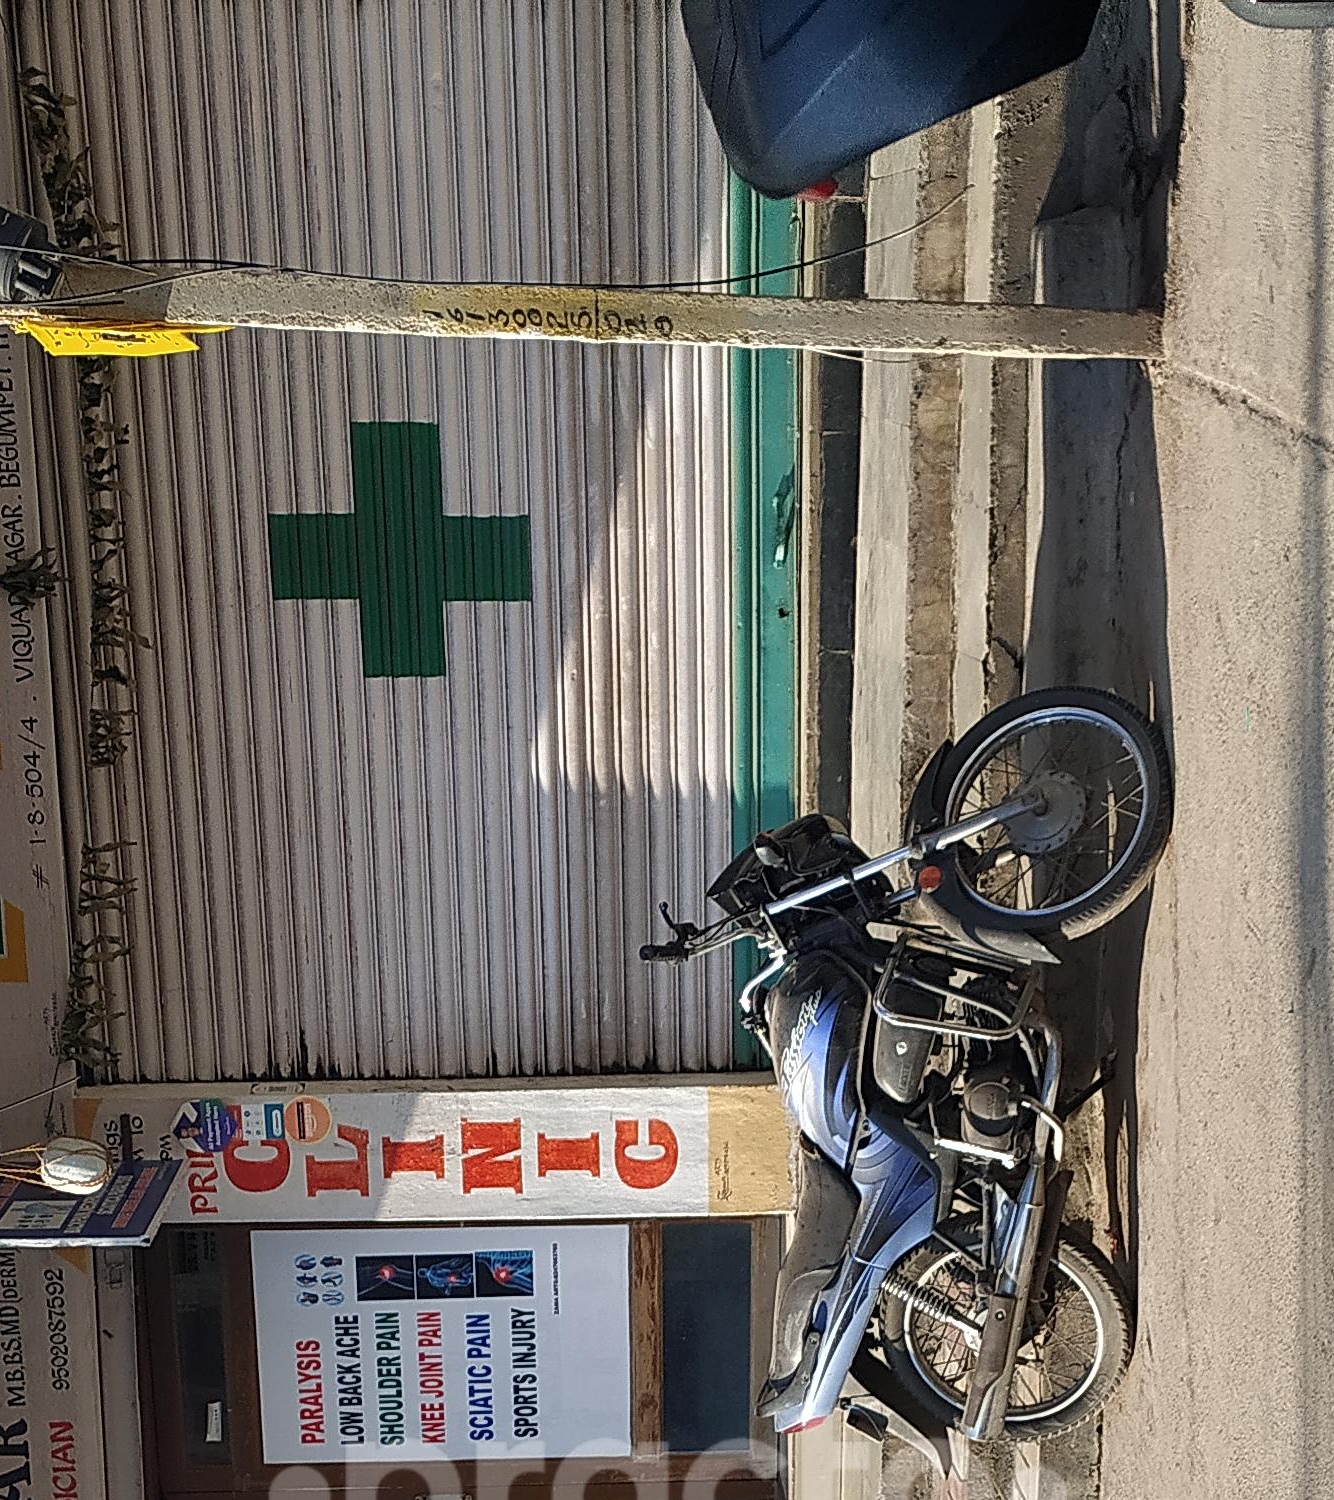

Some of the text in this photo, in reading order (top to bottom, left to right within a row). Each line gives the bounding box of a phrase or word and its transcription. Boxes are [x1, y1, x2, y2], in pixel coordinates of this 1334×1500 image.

[43, 1267, 70, 1391] 9502087592
[294, 1339, 326, 1445] PARALYSIS
[334, 1314, 365, 1445] LOW BACK ACHE
[374, 1312, 405, 1446] SHOULDER PAIN
[416, 1311, 446, 1444] KNEE JOINT PAIN
[465, 1314, 494, 1441] SCIATIC PAIN
[510, 1308, 539, 1438] SPORTS INJURY
